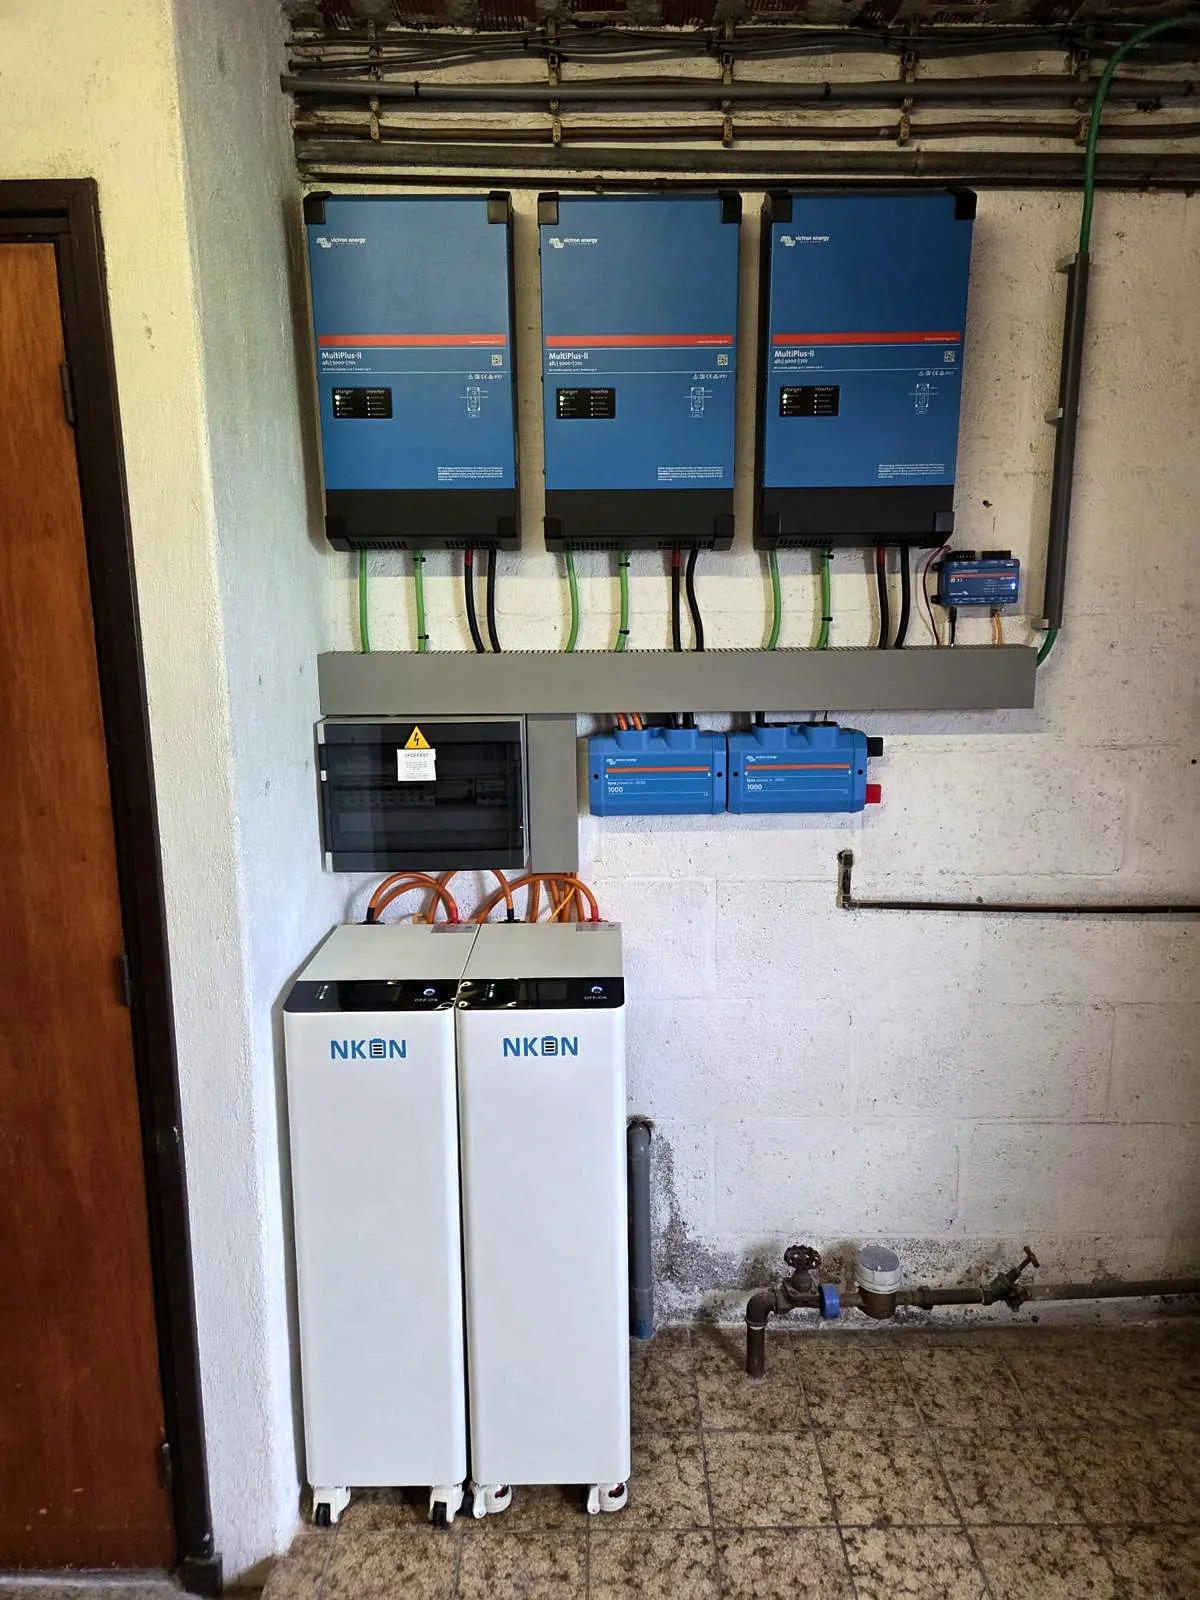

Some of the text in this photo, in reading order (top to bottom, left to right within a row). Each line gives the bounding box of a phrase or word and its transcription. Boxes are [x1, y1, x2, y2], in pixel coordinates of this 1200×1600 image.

[321, 351, 362, 360] MultiPlus-II
[548, 352, 589, 360] MultiPlus-II
[774, 350, 815, 359] MultiPlus-II
[330, 1038, 407, 1060] NKON
[502, 1035, 579, 1057] NKON
